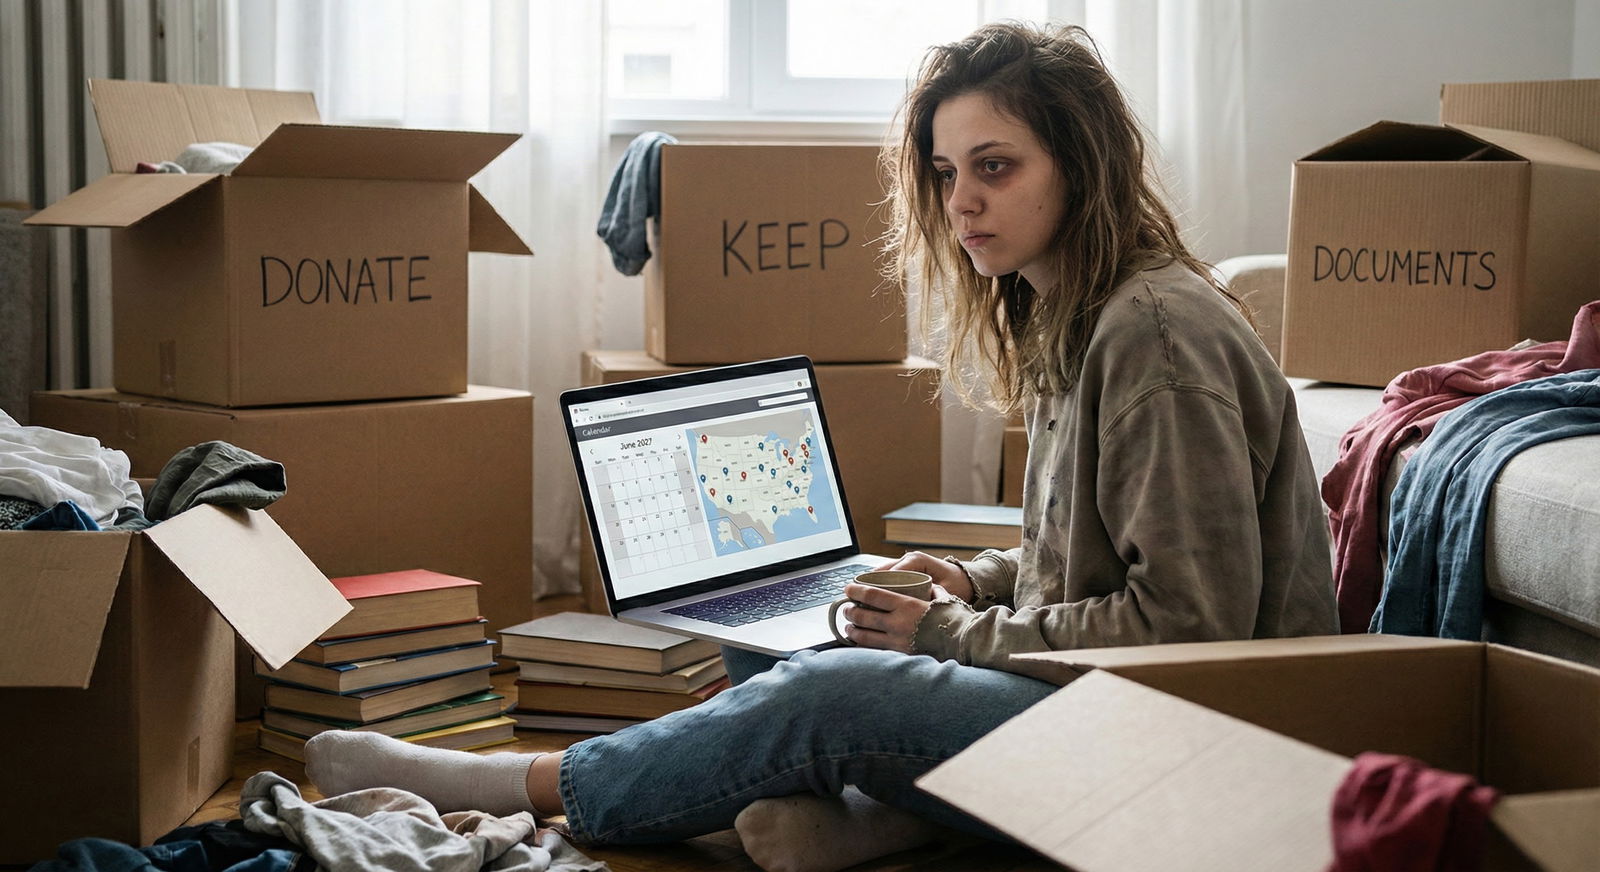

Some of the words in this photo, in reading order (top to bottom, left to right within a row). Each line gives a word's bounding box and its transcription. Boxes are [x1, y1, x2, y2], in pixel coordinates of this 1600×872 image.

[722, 218, 850, 277] KEEP
[1313, 244, 1496, 291] DOCUMENTS
[260, 254, 433, 308] DONATE
[582, 425, 612, 437] Calendar
[620, 442, 636, 451] June
[637, 437, 653, 447] 2027
